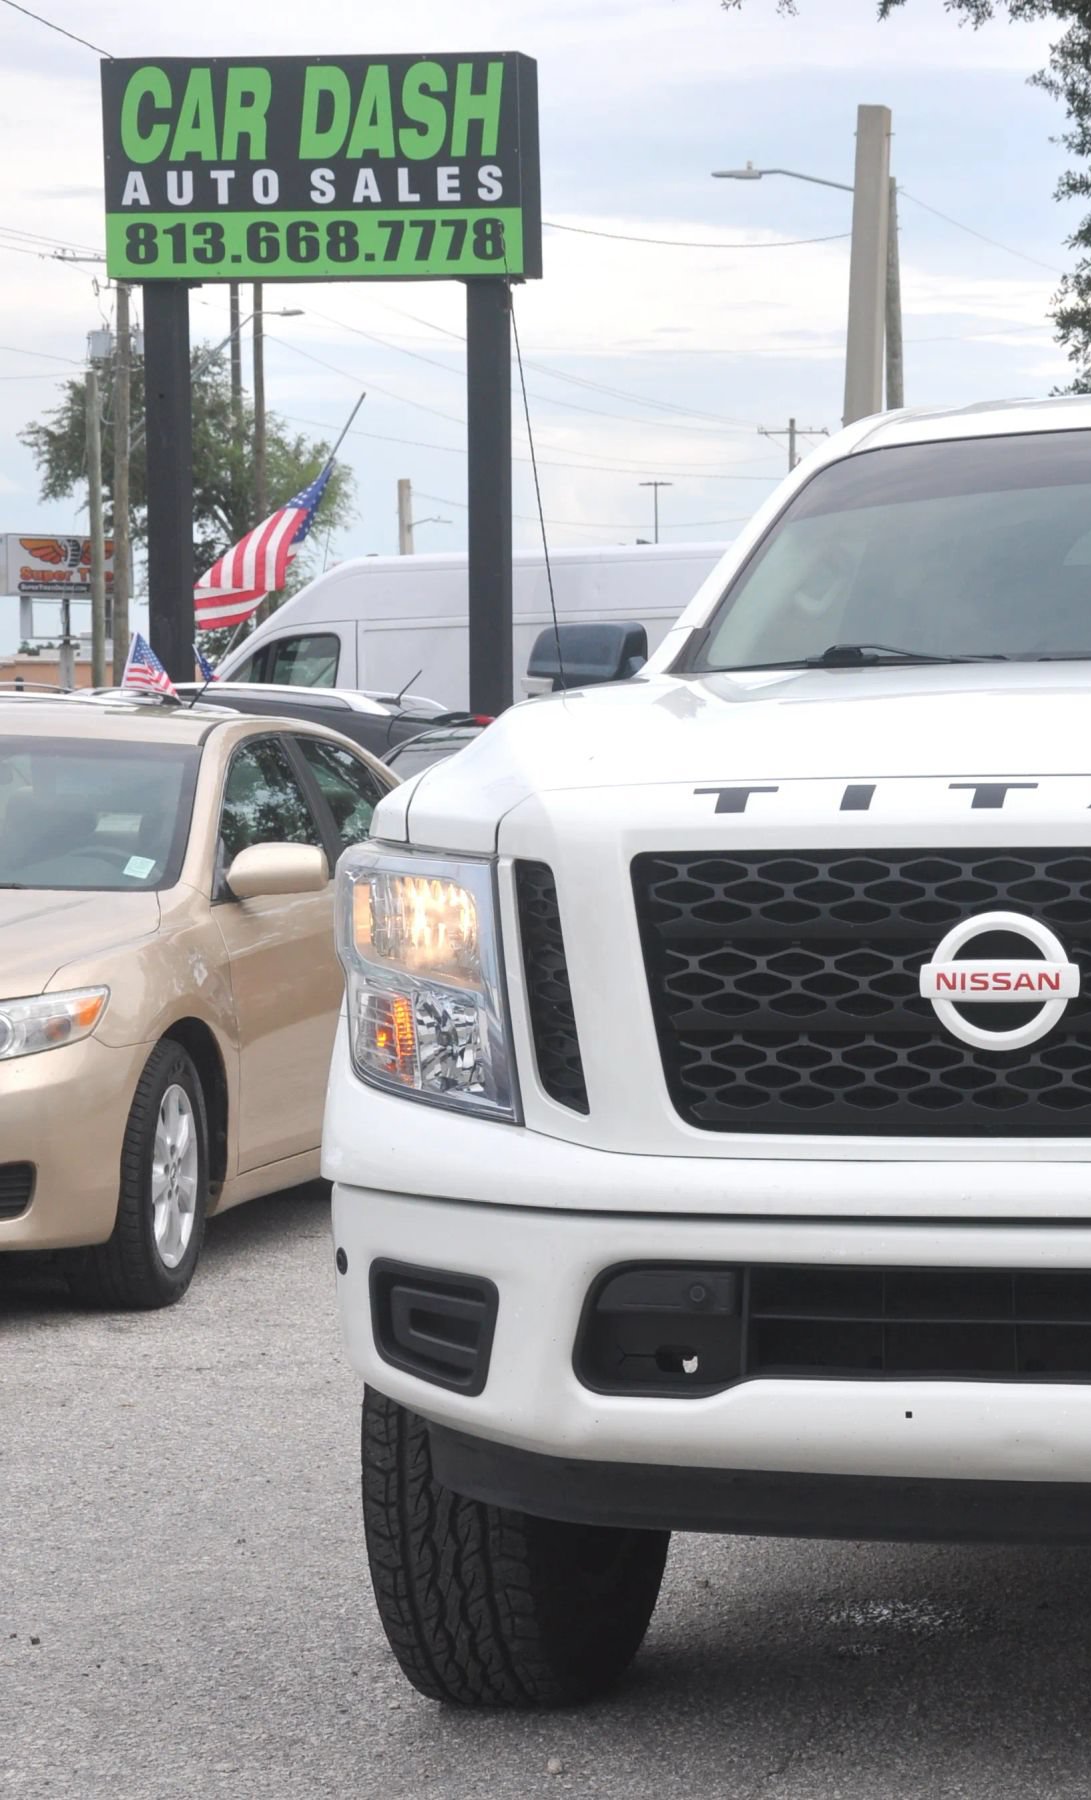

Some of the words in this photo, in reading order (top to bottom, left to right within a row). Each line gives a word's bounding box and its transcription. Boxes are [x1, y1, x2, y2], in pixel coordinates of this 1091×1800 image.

[120, 65, 272, 164] CAR
[299, 61, 504, 161] DASH
[121, 169, 280, 206] AUTO
[310, 165, 504, 203] SALES
[125, 217, 506, 265] 813.668.7778
[20, 567, 73, 583] Super
[936, 972, 1061, 991] NISSAN
